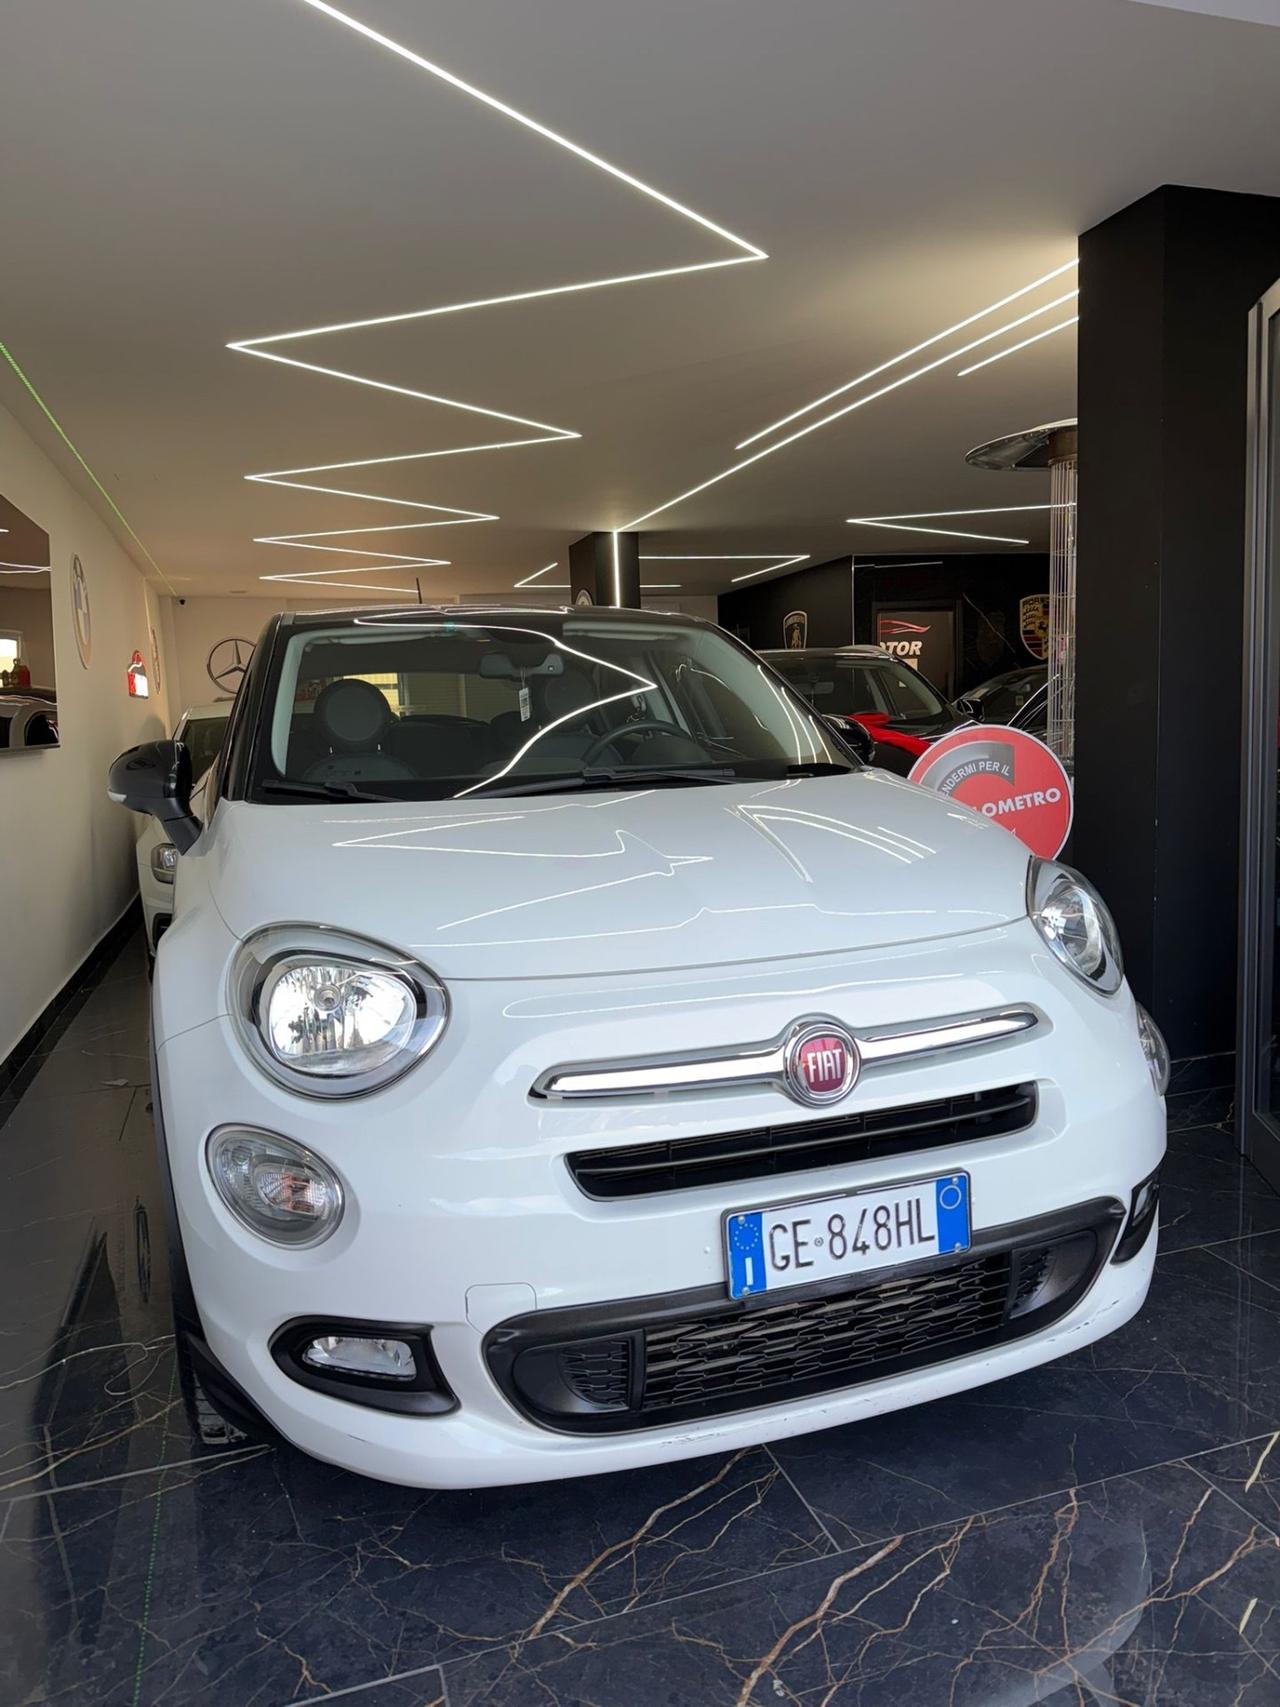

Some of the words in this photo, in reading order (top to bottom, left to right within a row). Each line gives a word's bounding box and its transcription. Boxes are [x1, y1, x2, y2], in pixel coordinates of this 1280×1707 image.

[980, 760, 999, 772] PER
[1001, 763, 1010, 777] IL
[972, 787, 1061, 818] OMETRO
[807, 1048, 842, 1083] FIAT
